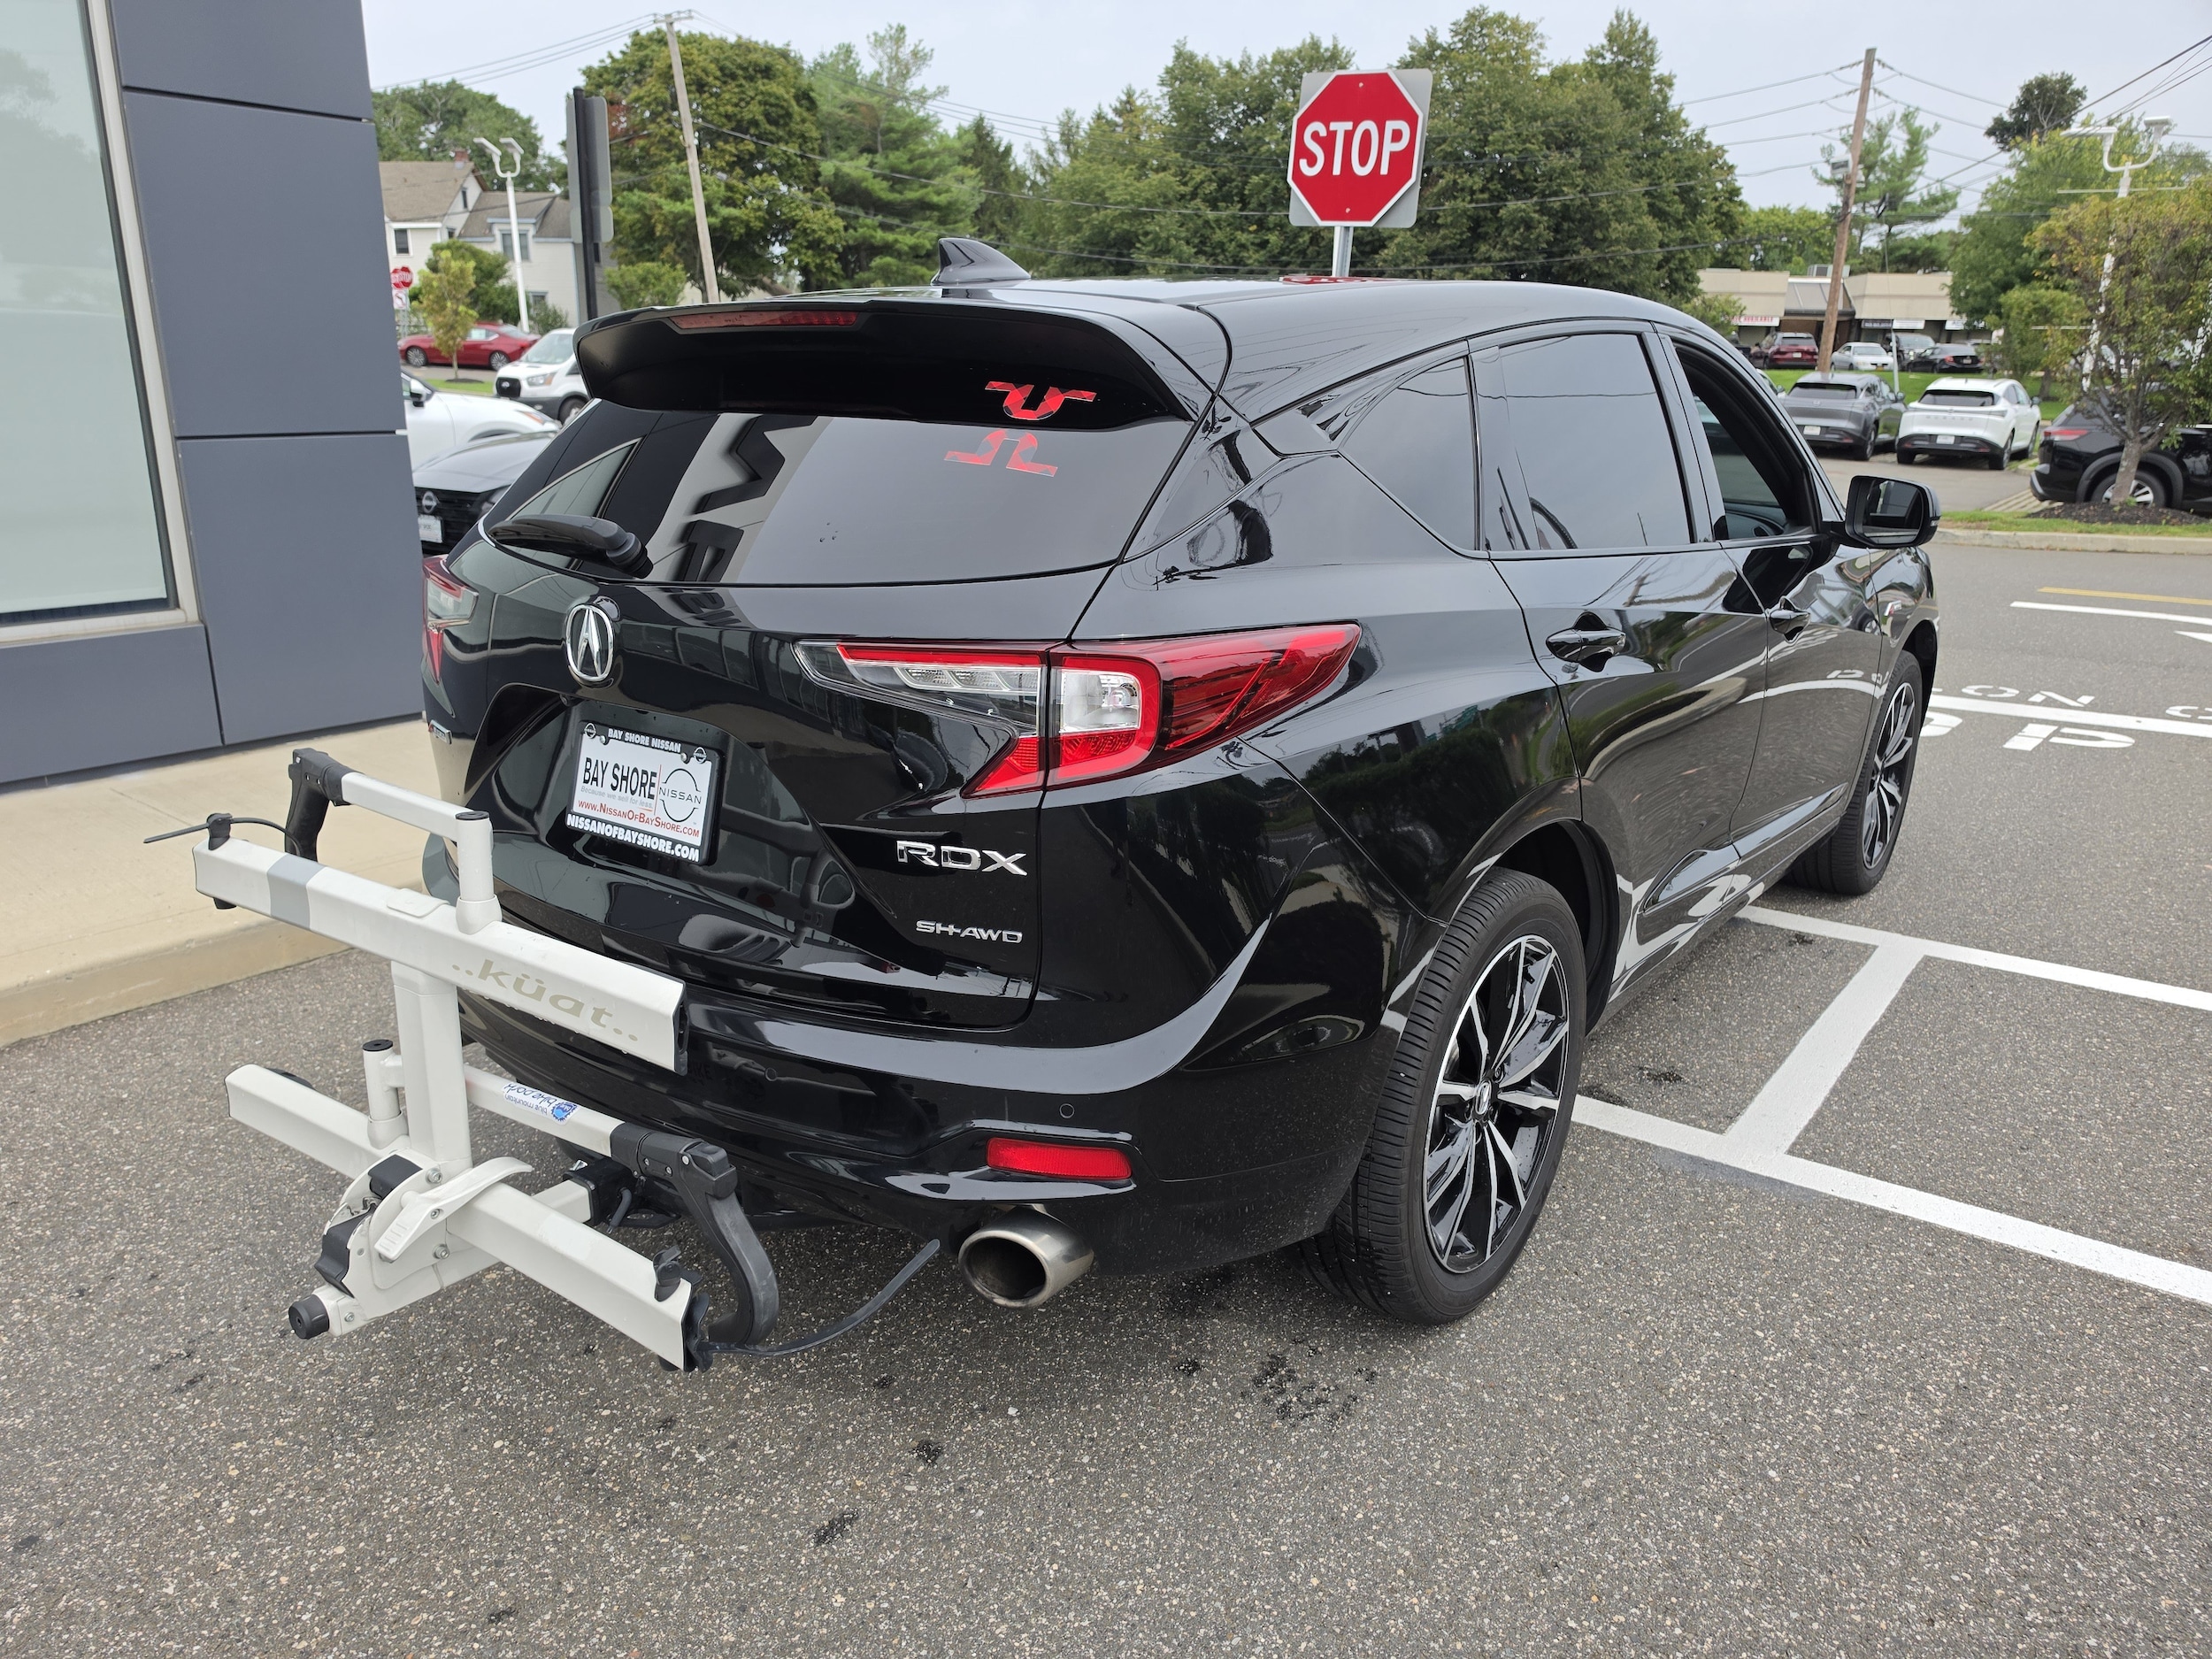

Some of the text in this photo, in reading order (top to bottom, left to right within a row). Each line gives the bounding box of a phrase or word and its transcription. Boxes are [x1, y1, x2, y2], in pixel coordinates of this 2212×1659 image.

[1299, 119, 1410, 177] STOP
[608, 728, 681, 752] BAY SHORE NISSAN
[583, 757, 657, 800] BAY SHORE
[580, 786, 605, 797] Because
[659, 787, 702, 804] NISSAN
[566, 813, 699, 862] NISSANOFBAYSHORE.COM
[896, 840, 1027, 876] RDX
[916, 920, 1023, 943] SH-AWD
[504, 1083, 537, 1096] park
[505, 1094, 534, 1109] mountain
[532, 1093, 557, 1108] bike
[535, 1104, 548, 1115] blue
